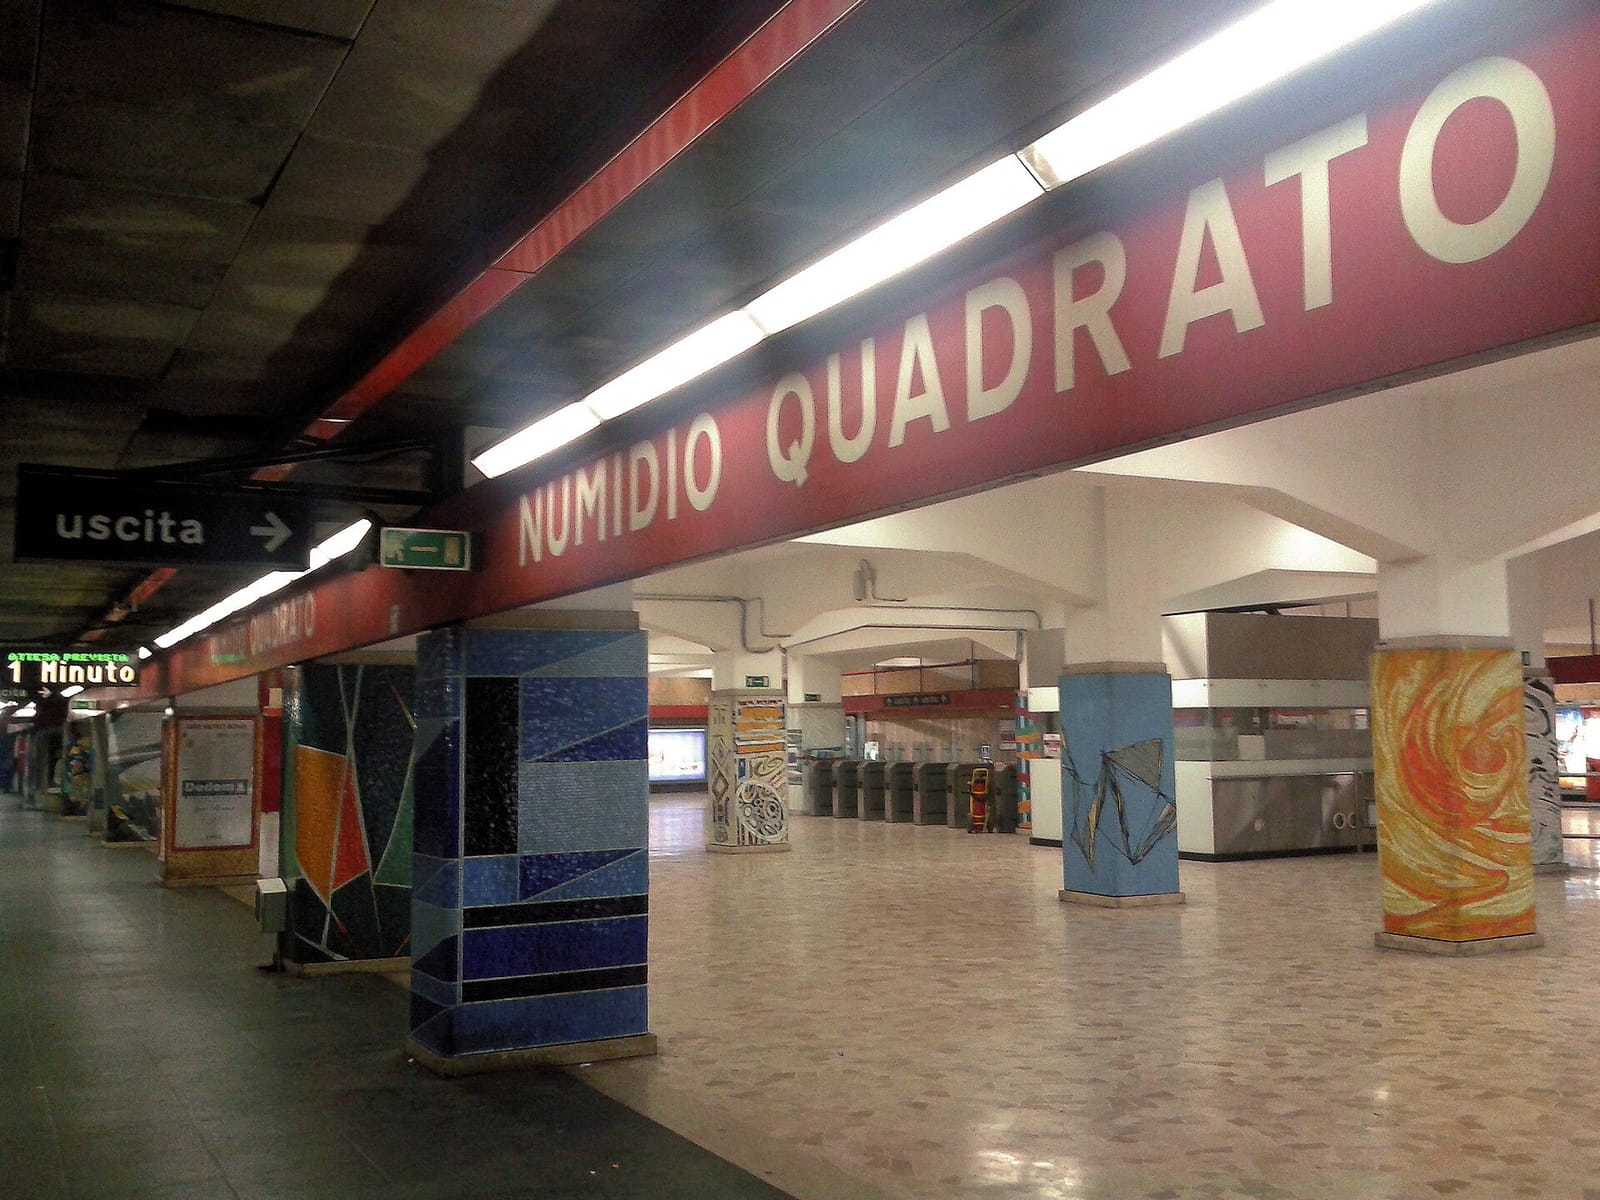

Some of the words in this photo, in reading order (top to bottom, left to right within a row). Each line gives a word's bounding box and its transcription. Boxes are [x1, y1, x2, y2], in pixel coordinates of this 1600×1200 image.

[518, 411, 722, 567] NUMIDIO
[766, 56, 1556, 487] QUADRATO
[56, 509, 204, 544] uscita
[8, 660, 21, 683] 1
[41, 660, 136, 683] Minuto
